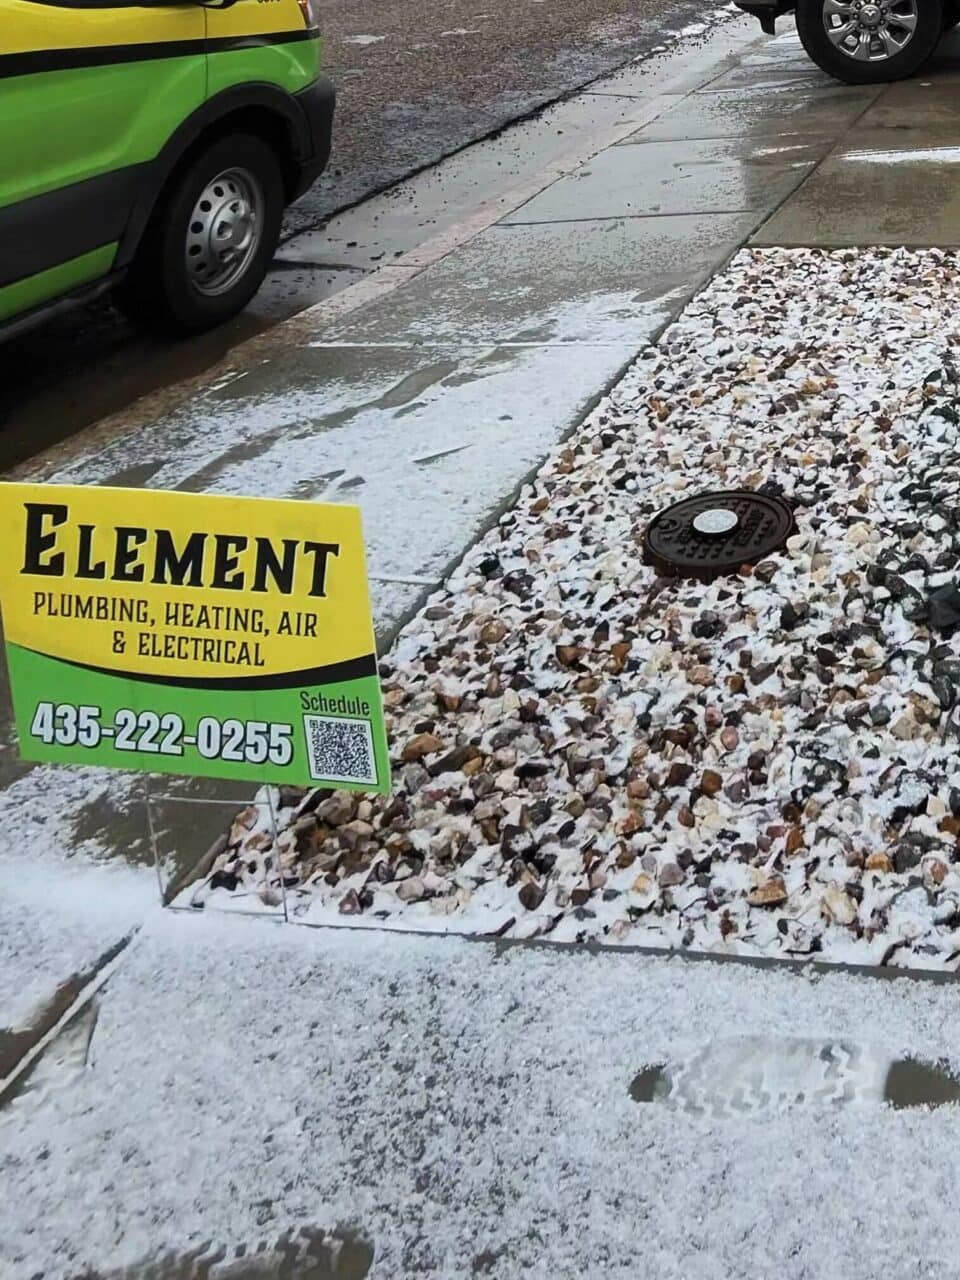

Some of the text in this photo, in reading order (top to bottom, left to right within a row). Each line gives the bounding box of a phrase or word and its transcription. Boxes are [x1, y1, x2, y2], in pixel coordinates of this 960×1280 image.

[20, 502, 340, 598] ELEMENT
[33, 592, 319, 638] PLUMBING, HEATING, AIR
[112, 631, 265, 667] & ELECTRICAL
[300, 690, 371, 716] Schedule
[31, 701, 293, 766] 435-222-0255
